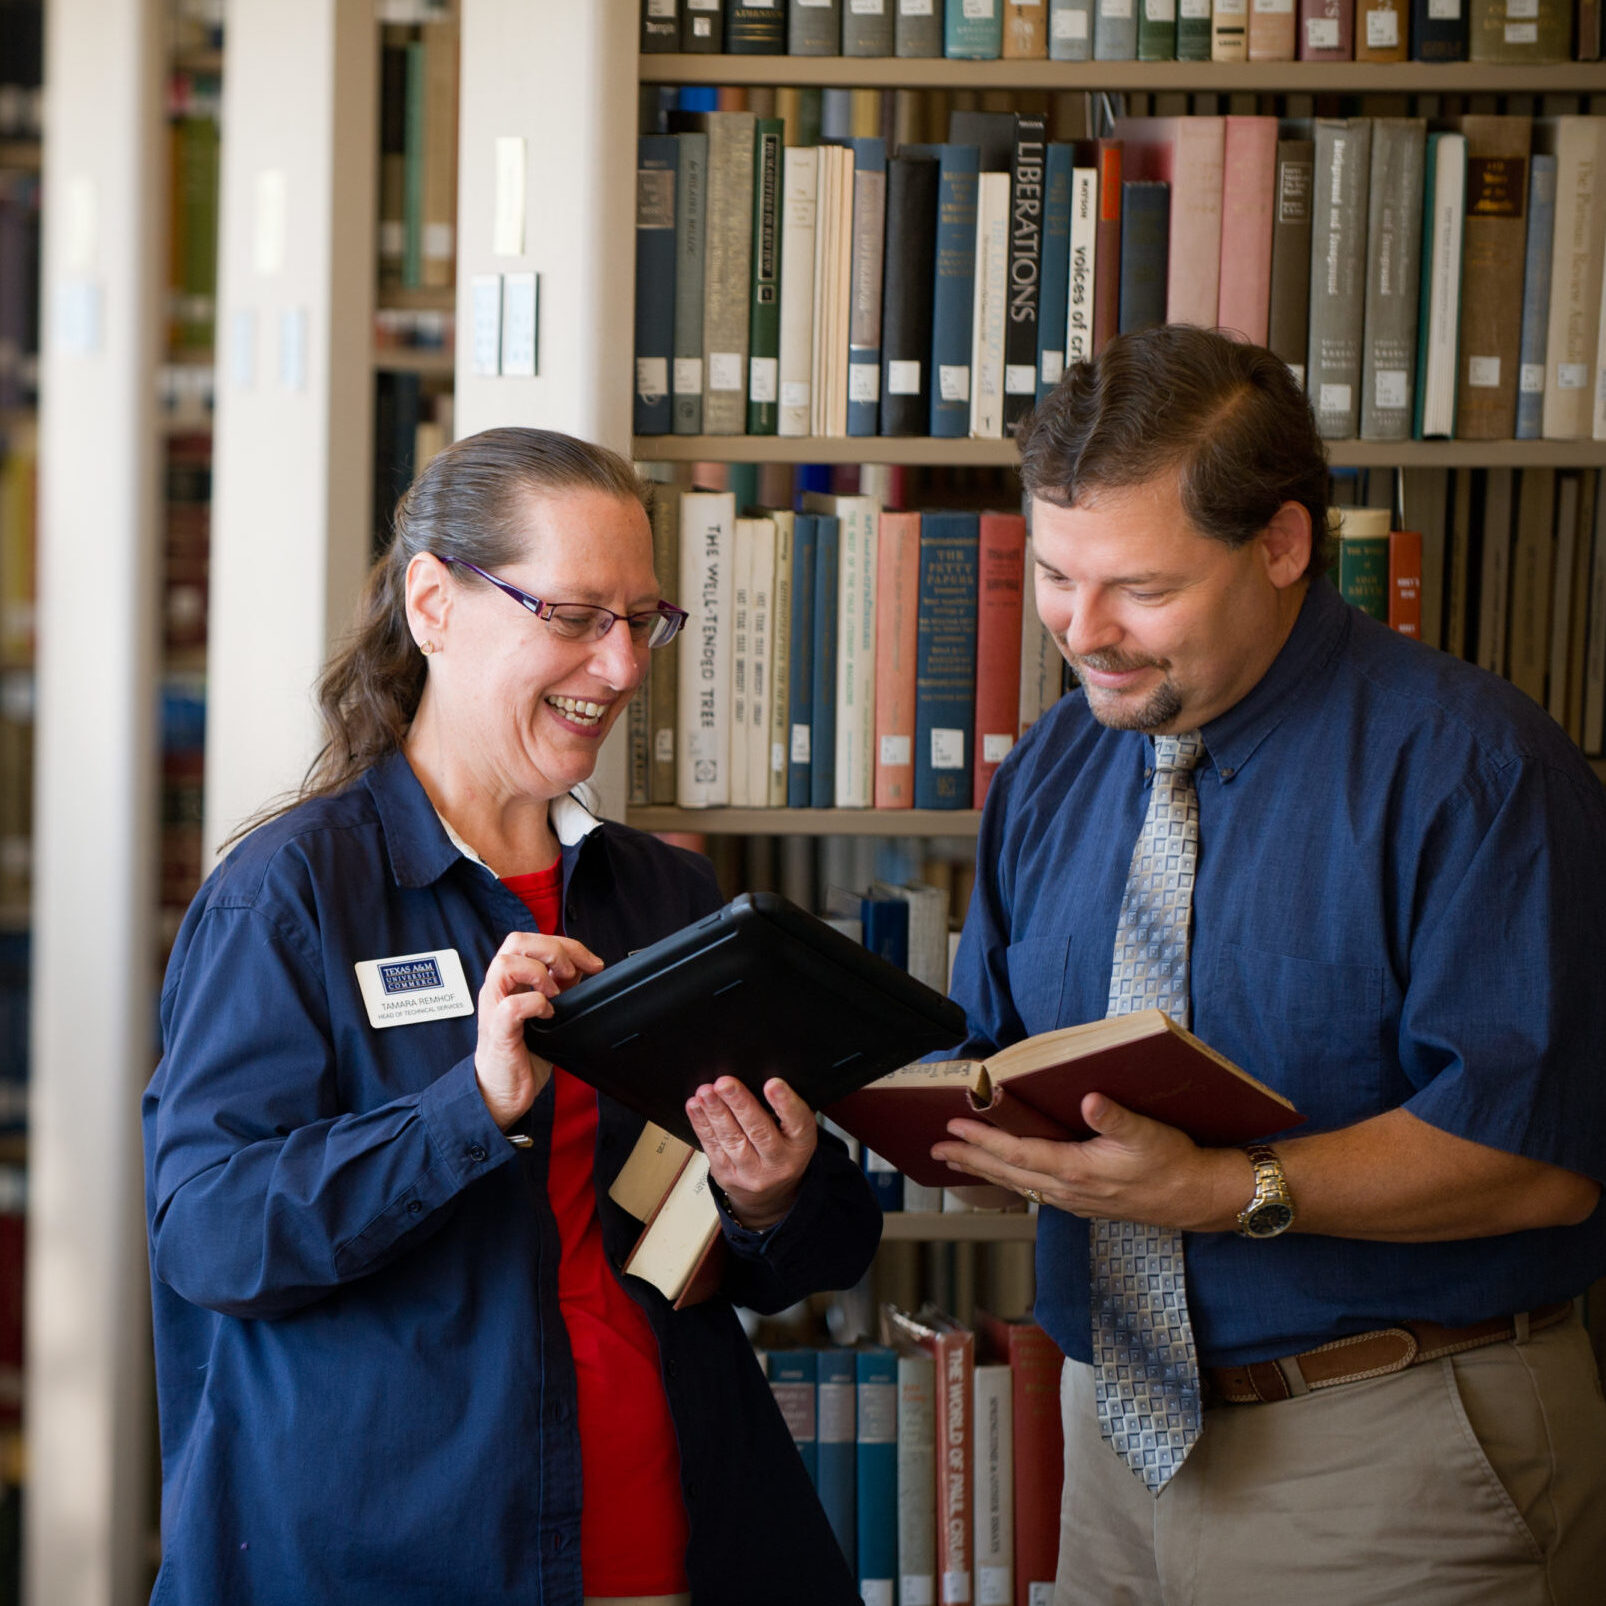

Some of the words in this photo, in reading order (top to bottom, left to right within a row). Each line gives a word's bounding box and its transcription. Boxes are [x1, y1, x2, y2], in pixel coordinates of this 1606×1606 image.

[1011, 142, 1043, 323] LIBERATIONS
[1072, 245, 1091, 305] voices
[1072, 311, 1089, 331] of
[707, 524, 723, 557] THE
[700, 563, 719, 680] WELL-TENDED
[700, 687, 716, 728] TREE
[383, 965, 411, 975] TEXAS
[413, 962, 434, 972] A&M
[386, 971, 436, 983] UNIVERSITY
[388, 978, 439, 990] COMMERCE
[382, 1000, 417, 1011] TAMARA
[418, 994, 456, 1005] REMHOF
[405, 1007, 436, 1017] TECHNICAL
[437, 1003, 464, 1011] SERVICES
[948, 1347, 964, 1382] THE
[948, 1382, 964, 1445] WORLD
[948, 1448, 965, 1472] OF
[949, 1473, 965, 1517] PAUL
